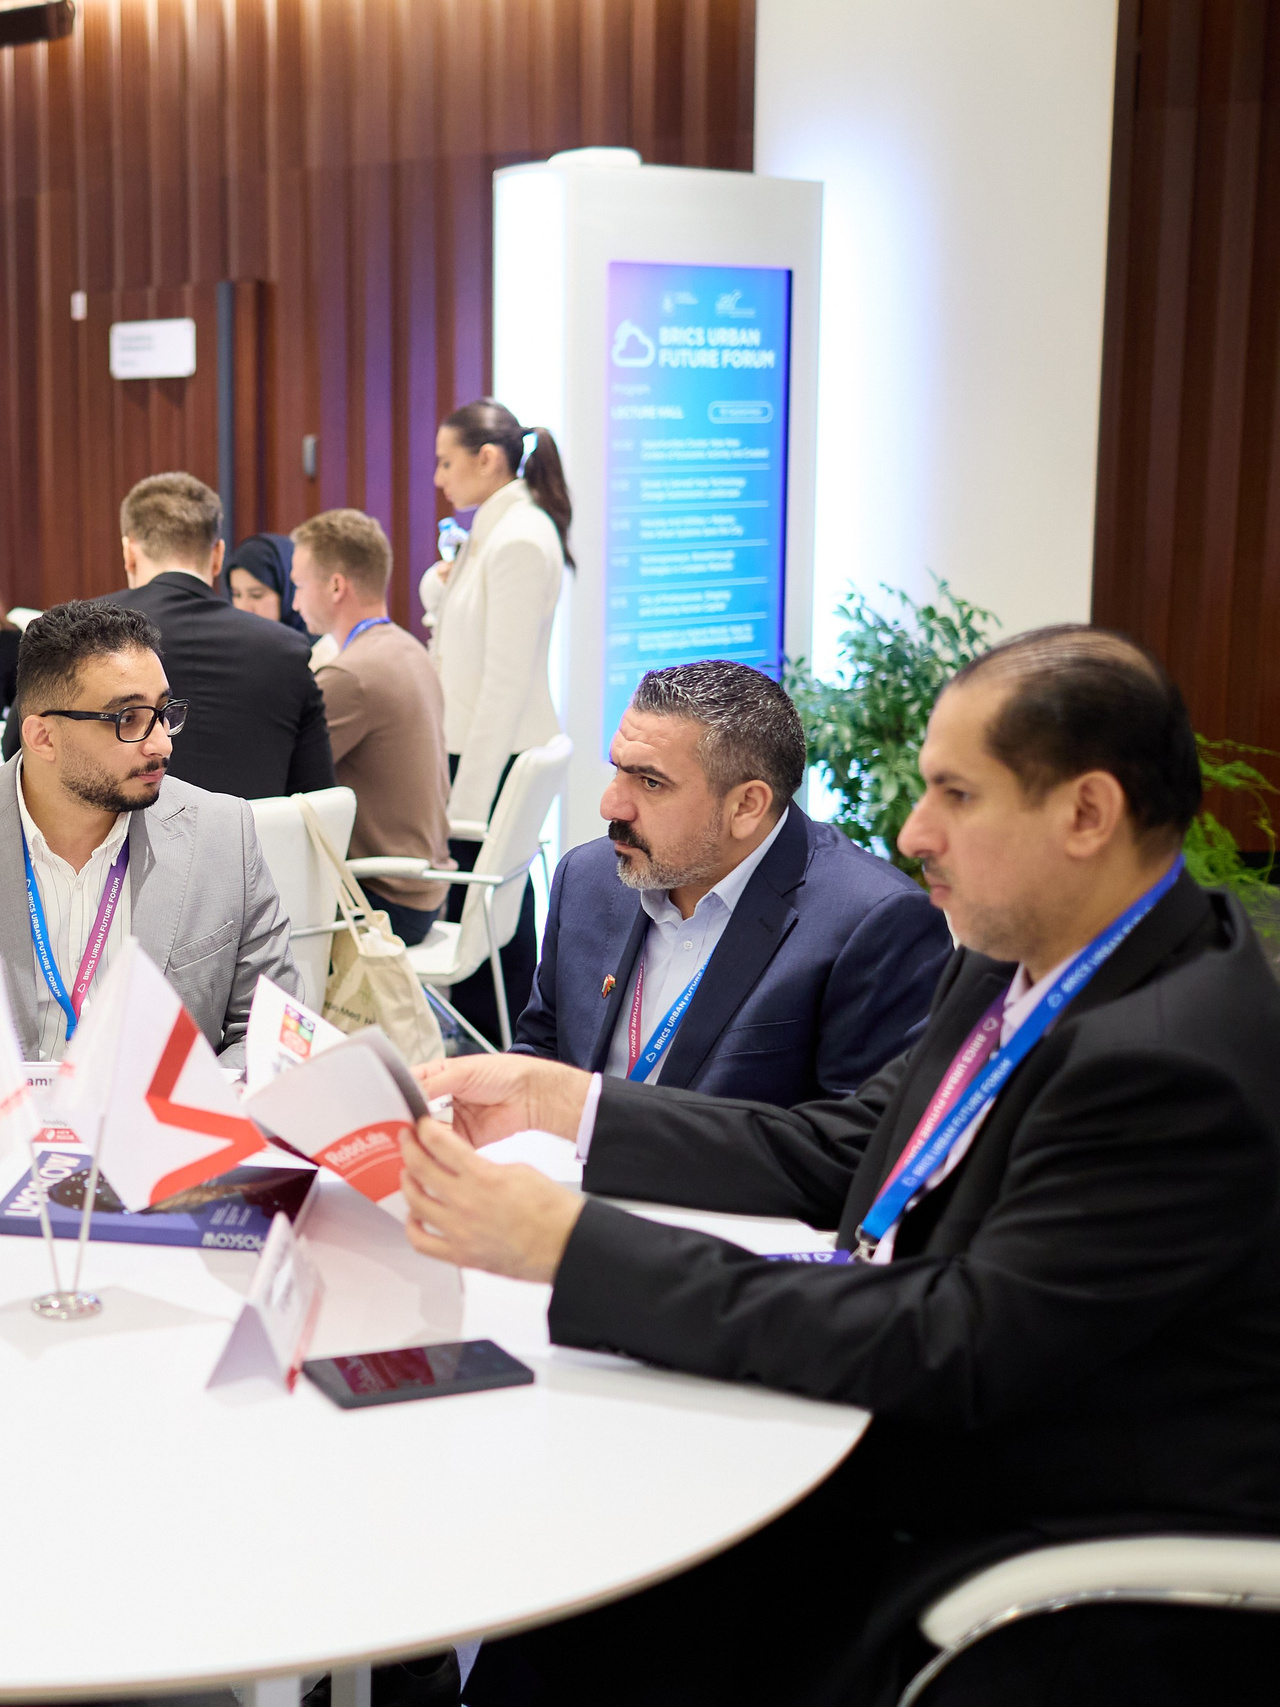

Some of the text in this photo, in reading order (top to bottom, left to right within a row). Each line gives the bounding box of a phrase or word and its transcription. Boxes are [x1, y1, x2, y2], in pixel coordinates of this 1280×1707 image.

[659, 327, 761, 346] BRICS URBAN
[659, 349, 775, 369] FUTURE FORUM
[82, 877, 120, 981] BRICS URBAN FUTURE FORUM
[31, 913, 42, 941] URBAN
[38, 940, 50, 971] FUTURE
[46, 971, 62, 998] FORUM
[631, 996, 640, 1028] FUTURE
[654, 1027, 671, 1051] BRICS
[667, 1001, 687, 1028] URBAN
[962, 1033, 987, 1063] BRICS
[941, 1063, 968, 1099] URBAN
[951, 1089, 985, 1127] FUTURE
[980, 1058, 1012, 1093] FORUM
[920, 1099, 946, 1139] FUTURE
